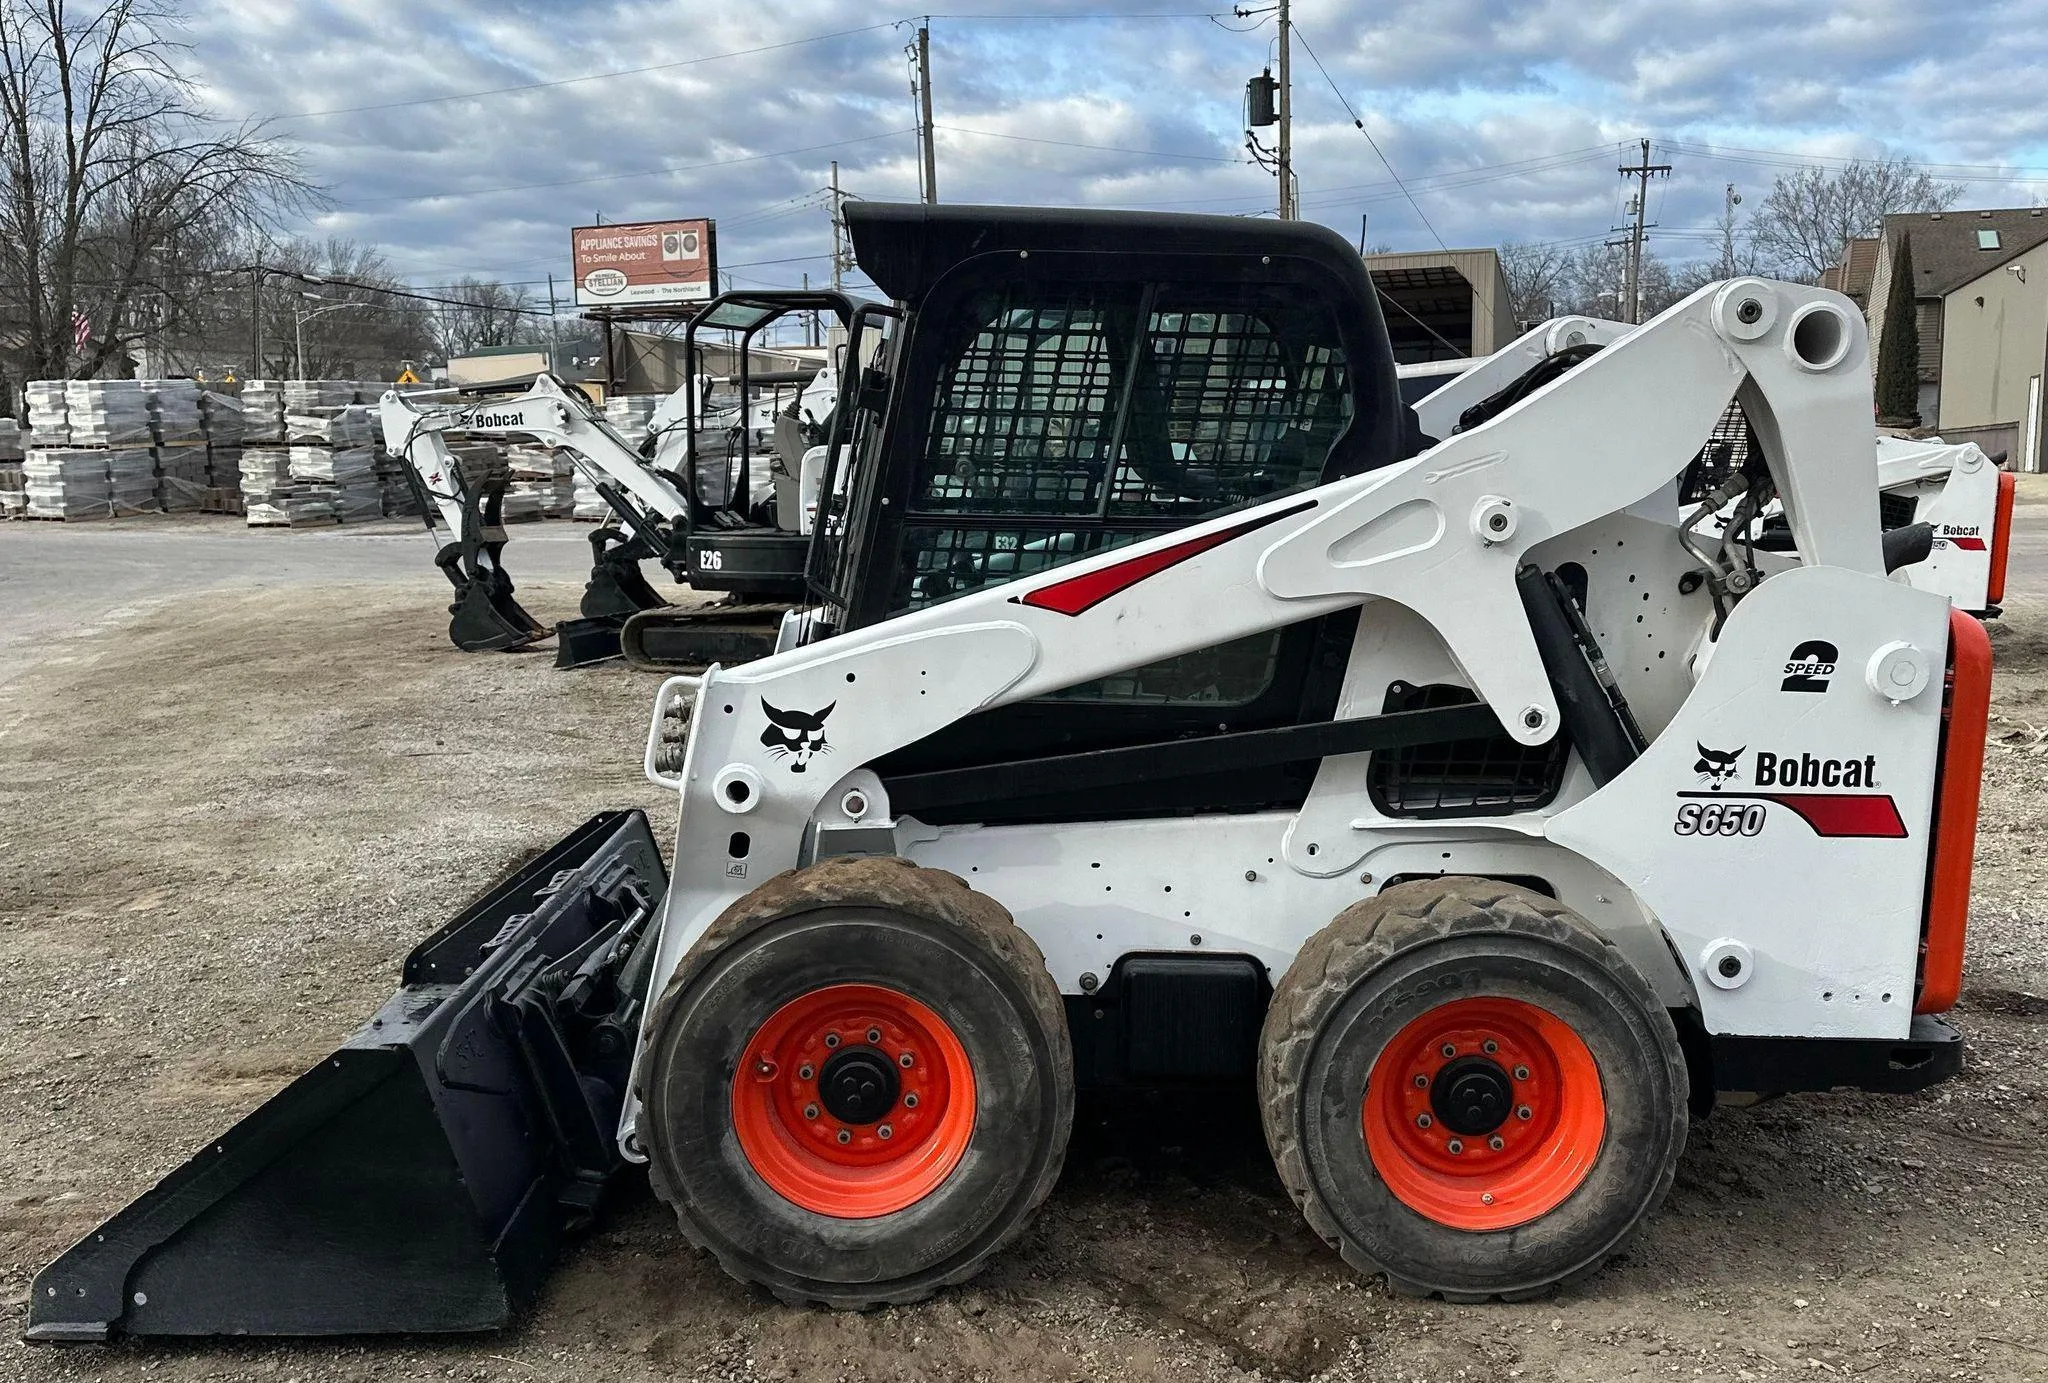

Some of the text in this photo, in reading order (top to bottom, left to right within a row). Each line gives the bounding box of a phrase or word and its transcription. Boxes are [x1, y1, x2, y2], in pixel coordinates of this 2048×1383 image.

[580, 234, 658, 251] APPLIANCE SAVINGS
[580, 251, 646, 263] To Smile About
[475, 412, 525, 428] Bobcat
[1943, 524, 1980, 536] Bobcat
[995, 535, 1018, 550] E32
[700, 550, 722, 570] E26
[1780, 639, 1840, 693] 2 SPEED
[1754, 752, 1876, 788] Bobcat
[1674, 803, 1767, 837] S650
